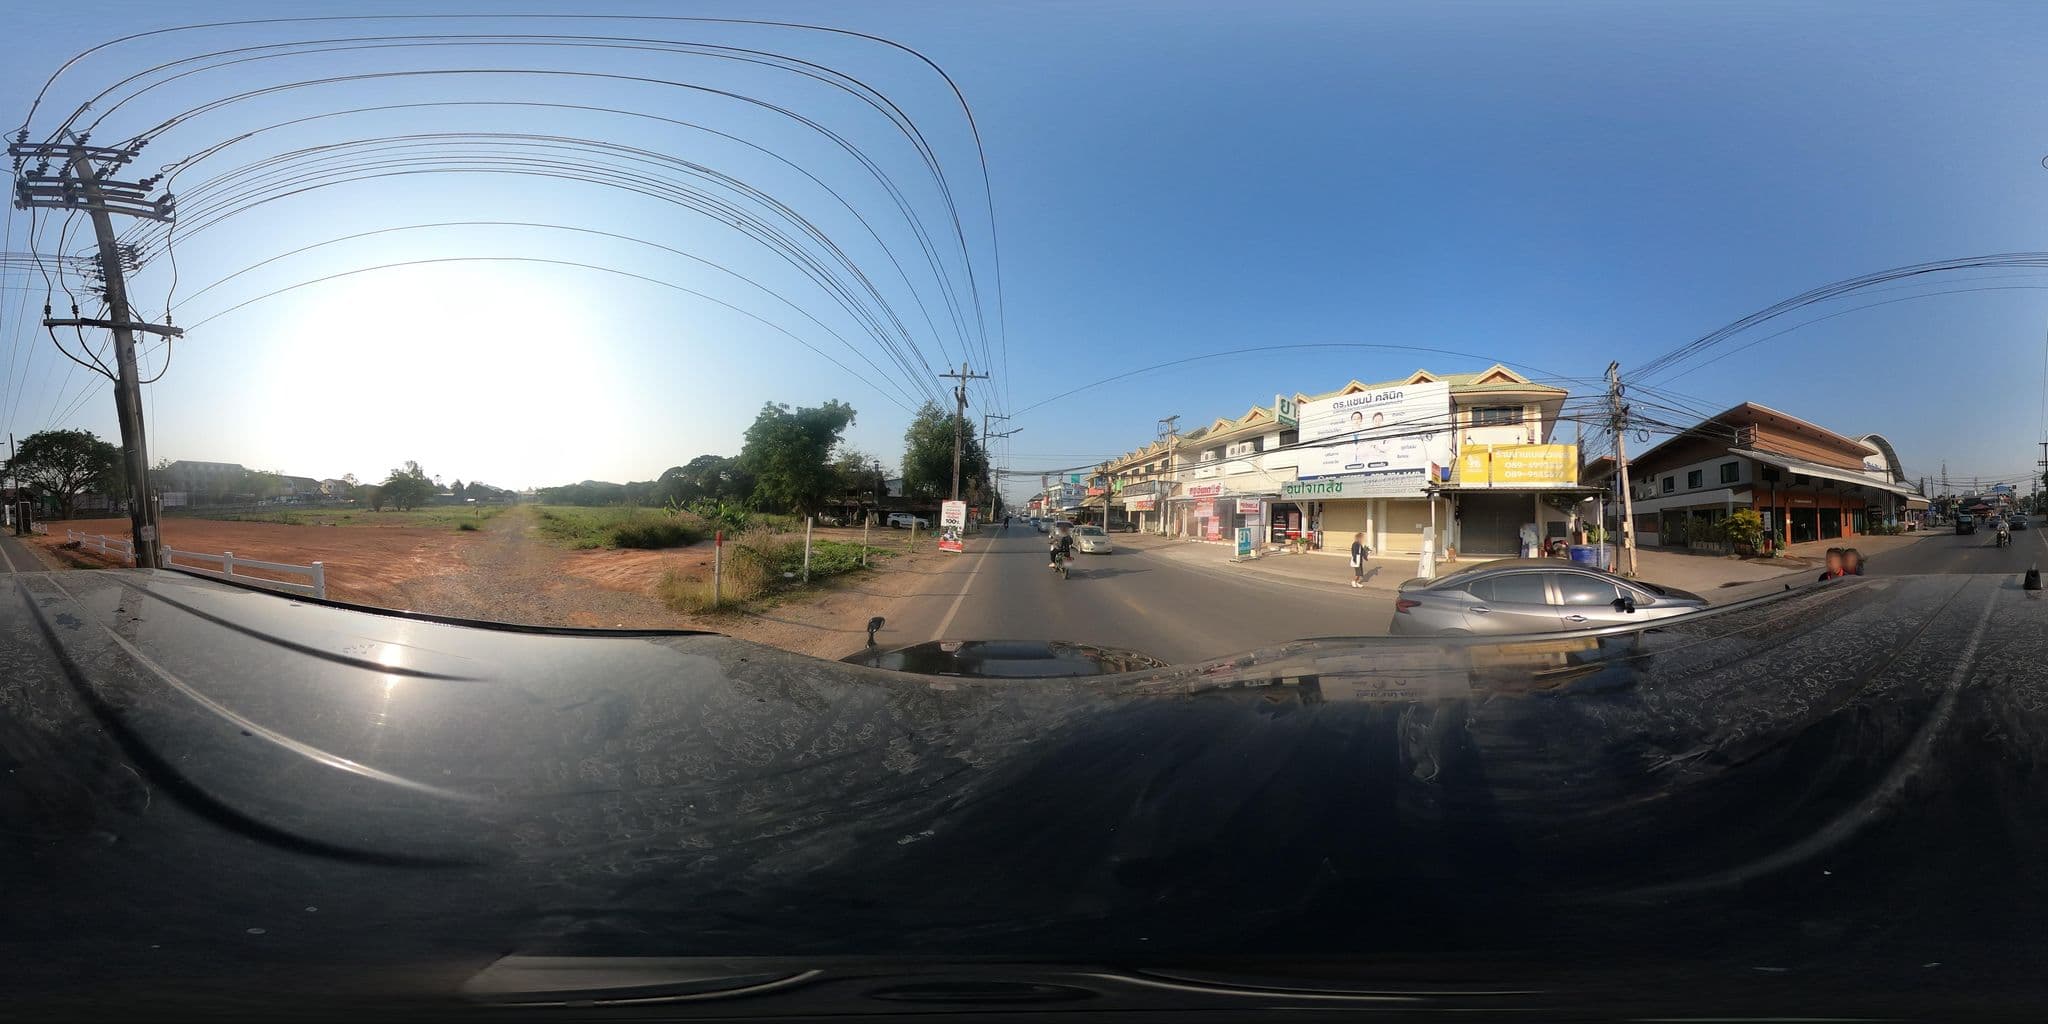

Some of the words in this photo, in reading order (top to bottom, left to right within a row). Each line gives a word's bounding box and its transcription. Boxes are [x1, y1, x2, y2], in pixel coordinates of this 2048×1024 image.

[1375, 390, 1403, 402] คลินิก
[1280, 398, 1297, 418] ยา
